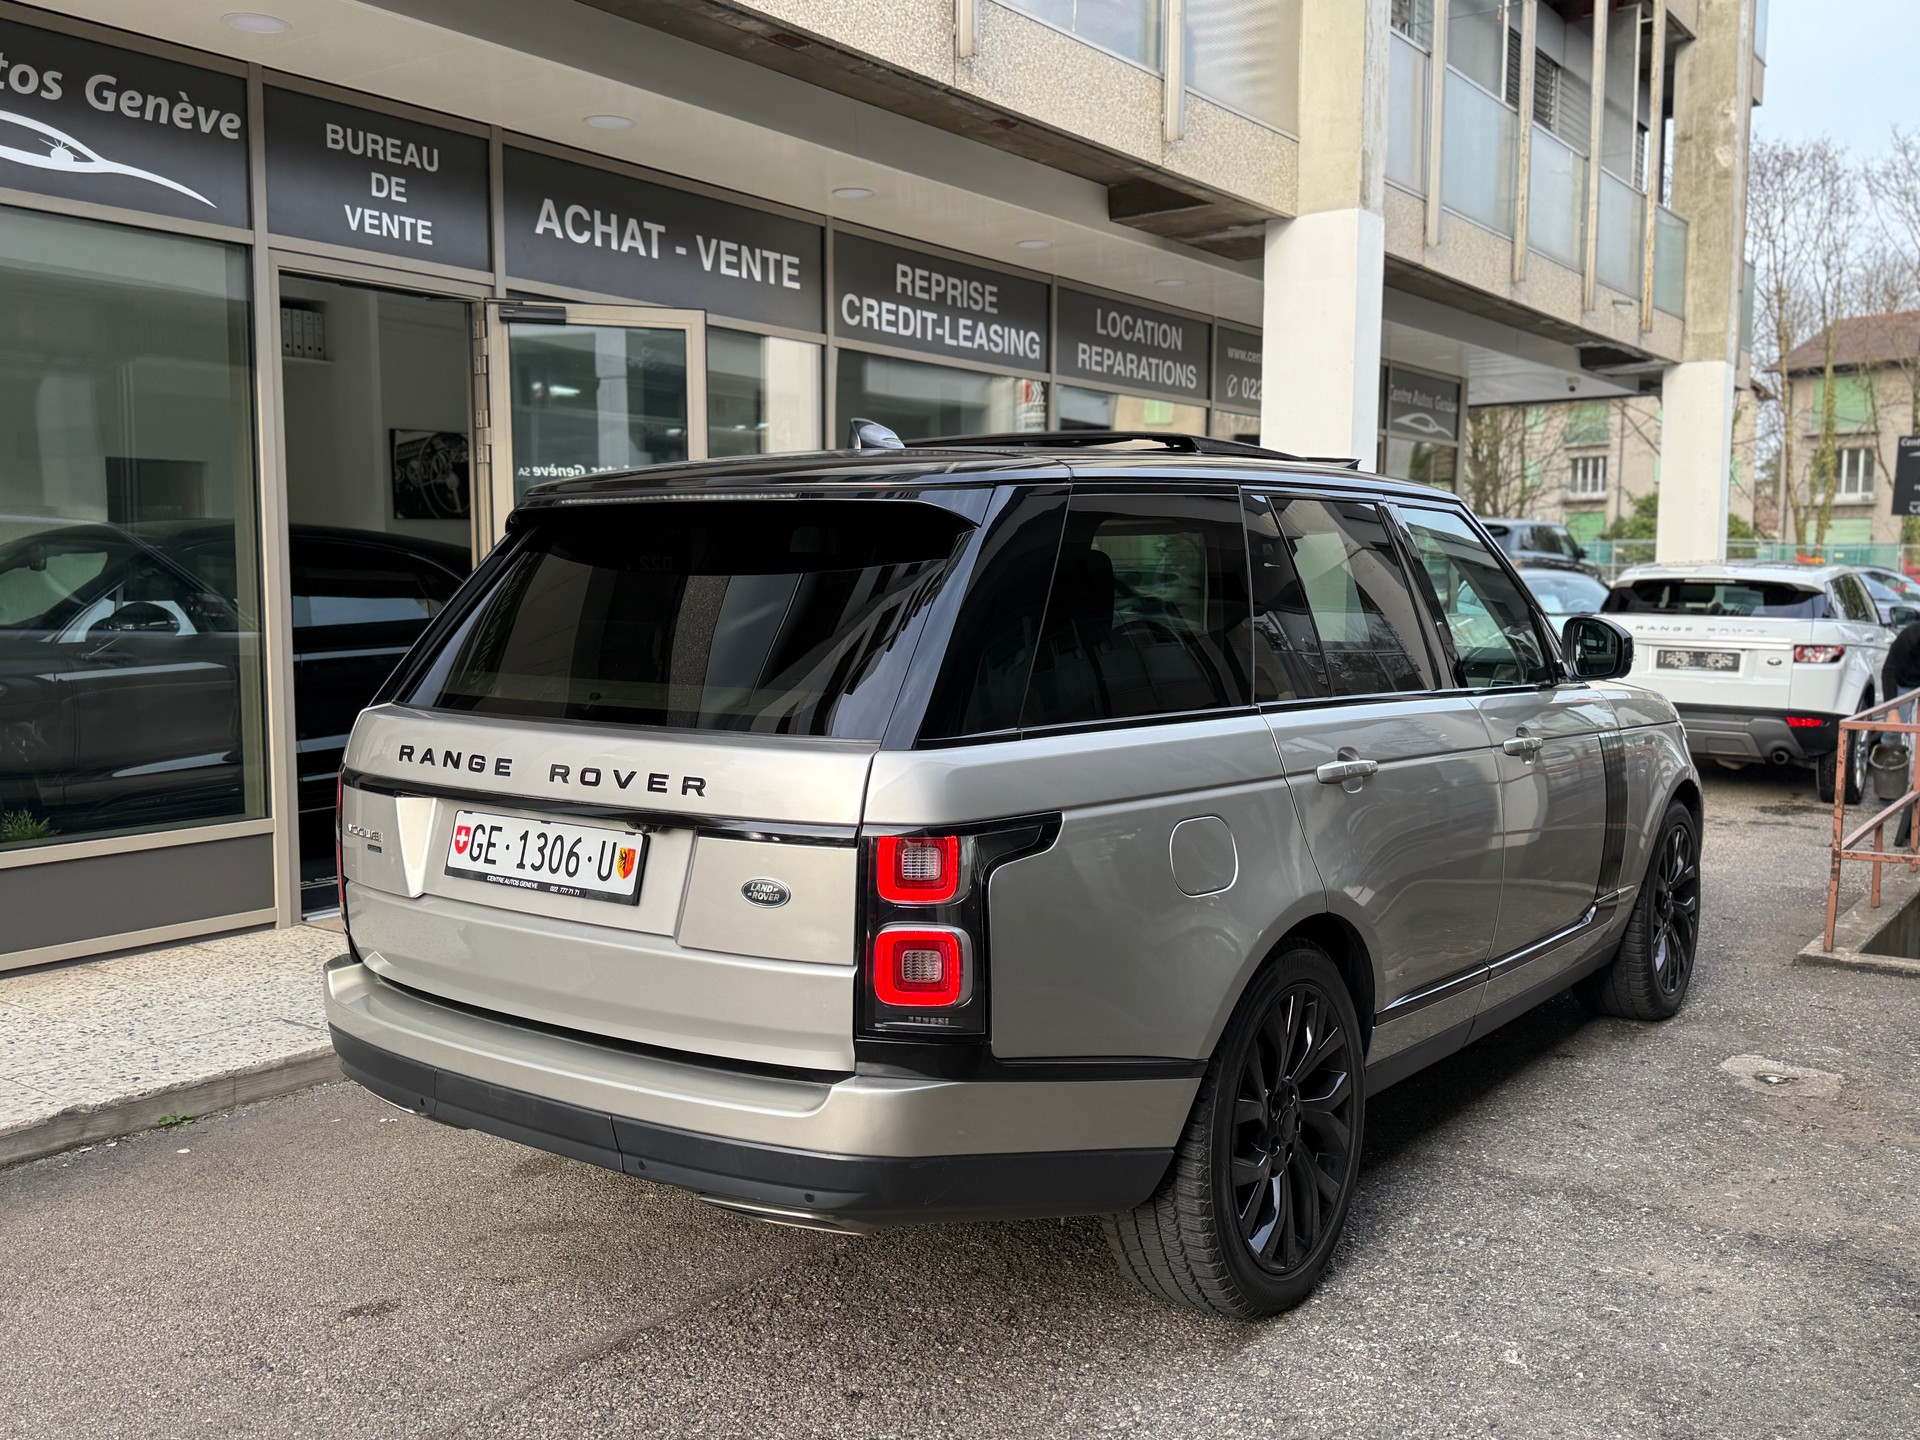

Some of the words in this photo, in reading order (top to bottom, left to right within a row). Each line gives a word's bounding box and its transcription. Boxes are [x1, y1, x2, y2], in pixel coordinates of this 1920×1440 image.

[85, 73, 241, 139] Genève
[326, 122, 439, 172] BUREAU
[371, 172, 407, 203] DE
[344, 204, 433, 245] VENTE
[535, 198, 666, 259] ACHAT
[696, 235, 800, 290] VENTE
[896, 263, 998, 314] REPRISE
[841, 293, 1041, 360] CREDIT-LEASING
[1096, 308, 1183, 352] LOCATION
[1077, 342, 1197, 389] REPARATIONS
[398, 744, 513, 777] RANGE
[549, 763, 707, 798] ROVER
[487, 875, 504, 884] CENTRE
[504, 878, 520, 886] AUTOS
[750, 882, 774, 893] LAND
[751, 891, 781, 902] ROVER
